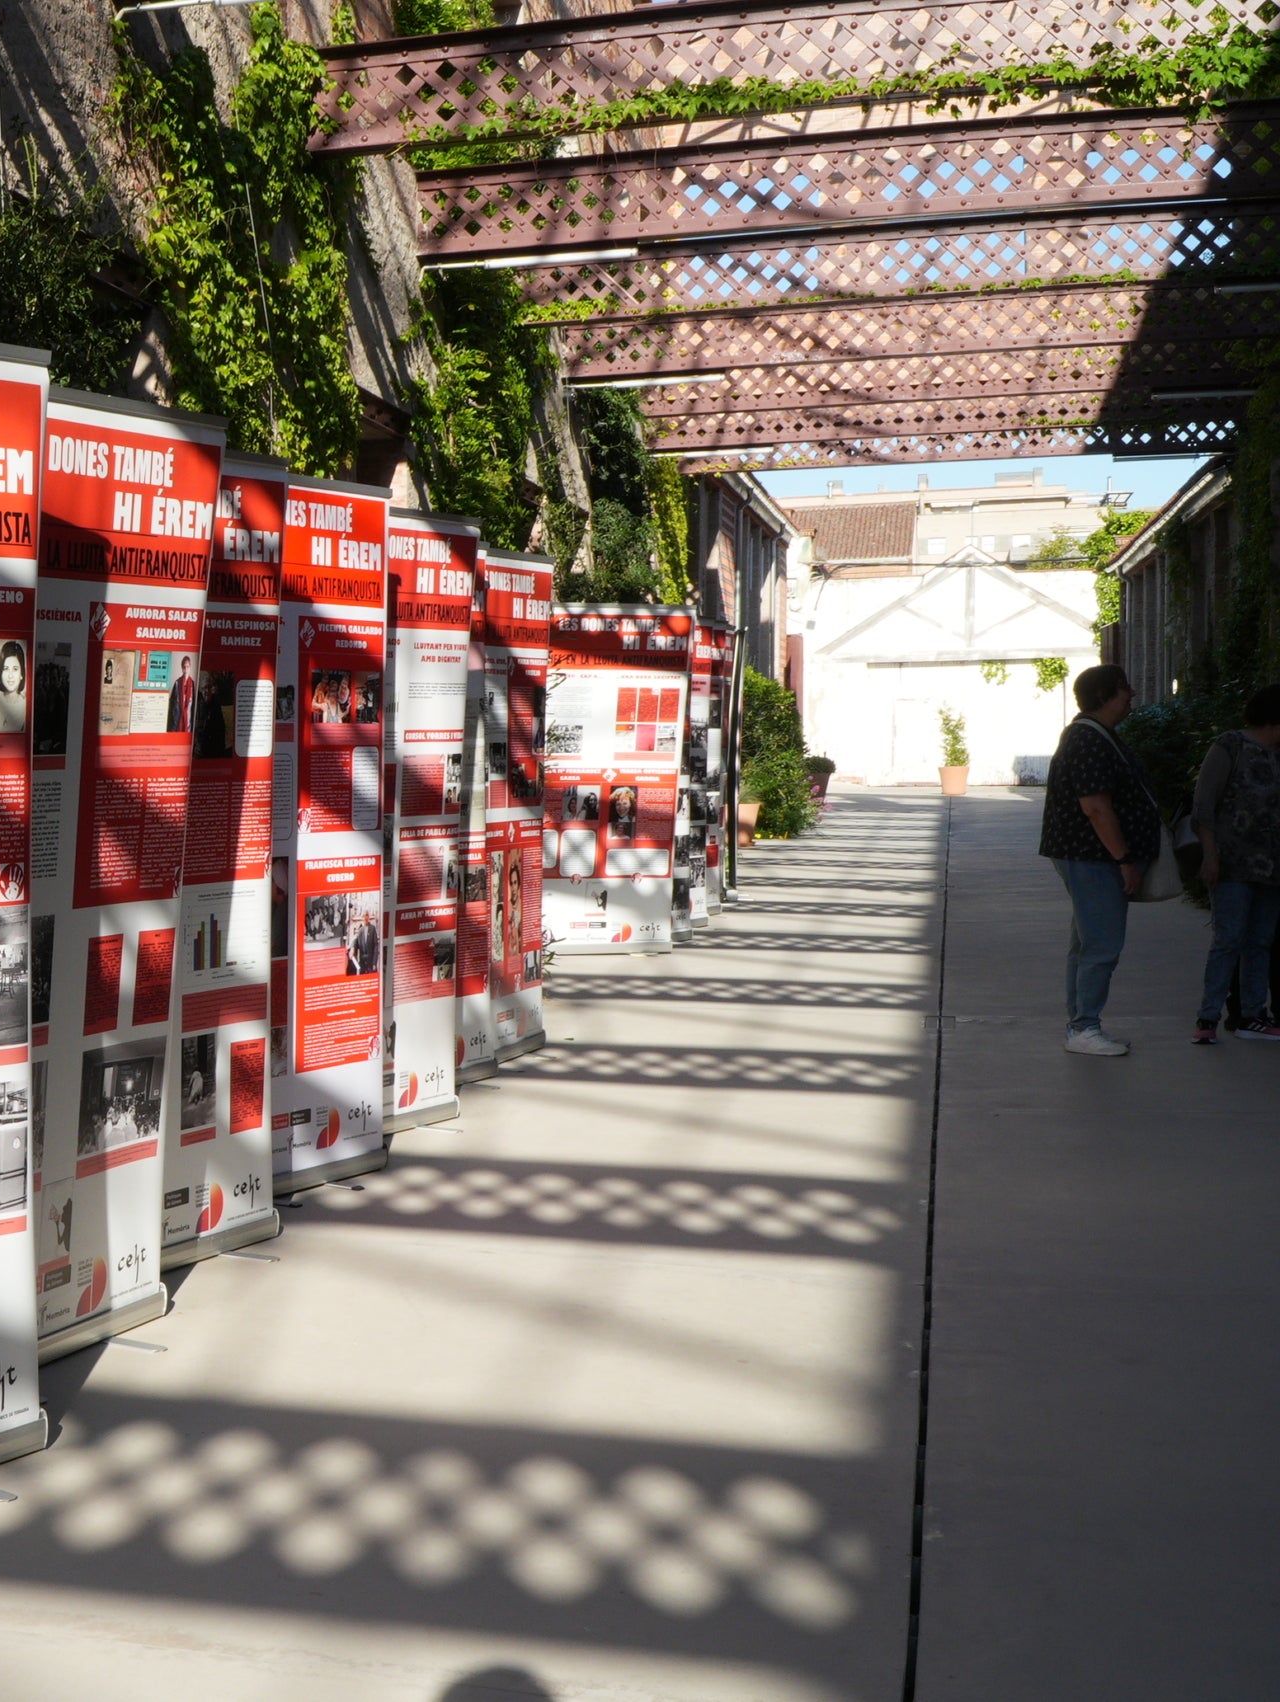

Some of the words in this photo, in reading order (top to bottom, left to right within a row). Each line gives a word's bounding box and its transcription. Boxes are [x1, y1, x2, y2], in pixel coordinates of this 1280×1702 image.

[48, 434, 109, 479] DONES
[113, 447, 174, 488] TAMBÉ
[113, 491, 142, 532] HI
[150, 488, 214, 540] ÉREM
[309, 503, 353, 533] TAMBÉ
[223, 521, 280, 564] ÉREM
[311, 536, 331, 566] HI
[338, 534, 382, 571] ÉREM
[389, 535, 415, 560] ONES
[416, 537, 451, 564] TAMBÉ
[110, 545, 208, 580] ANTIFRANQUISTA
[312, 577, 381, 601] ANTIFRANQUISTA
[416, 567, 435, 594] HI
[439, 564, 473, 596] ÉREM
[126, 607, 166, 621] AURORA
[168, 609, 198, 623] SALAS
[581, 618, 619, 632] DONES
[622, 617, 661, 633] TAMBÉ
[136, 627, 186, 640] SALVADOR
[623, 635, 640, 650] HI
[647, 633, 687, 651] ÉREM
[305, 859, 343, 870] FRANCISCA
